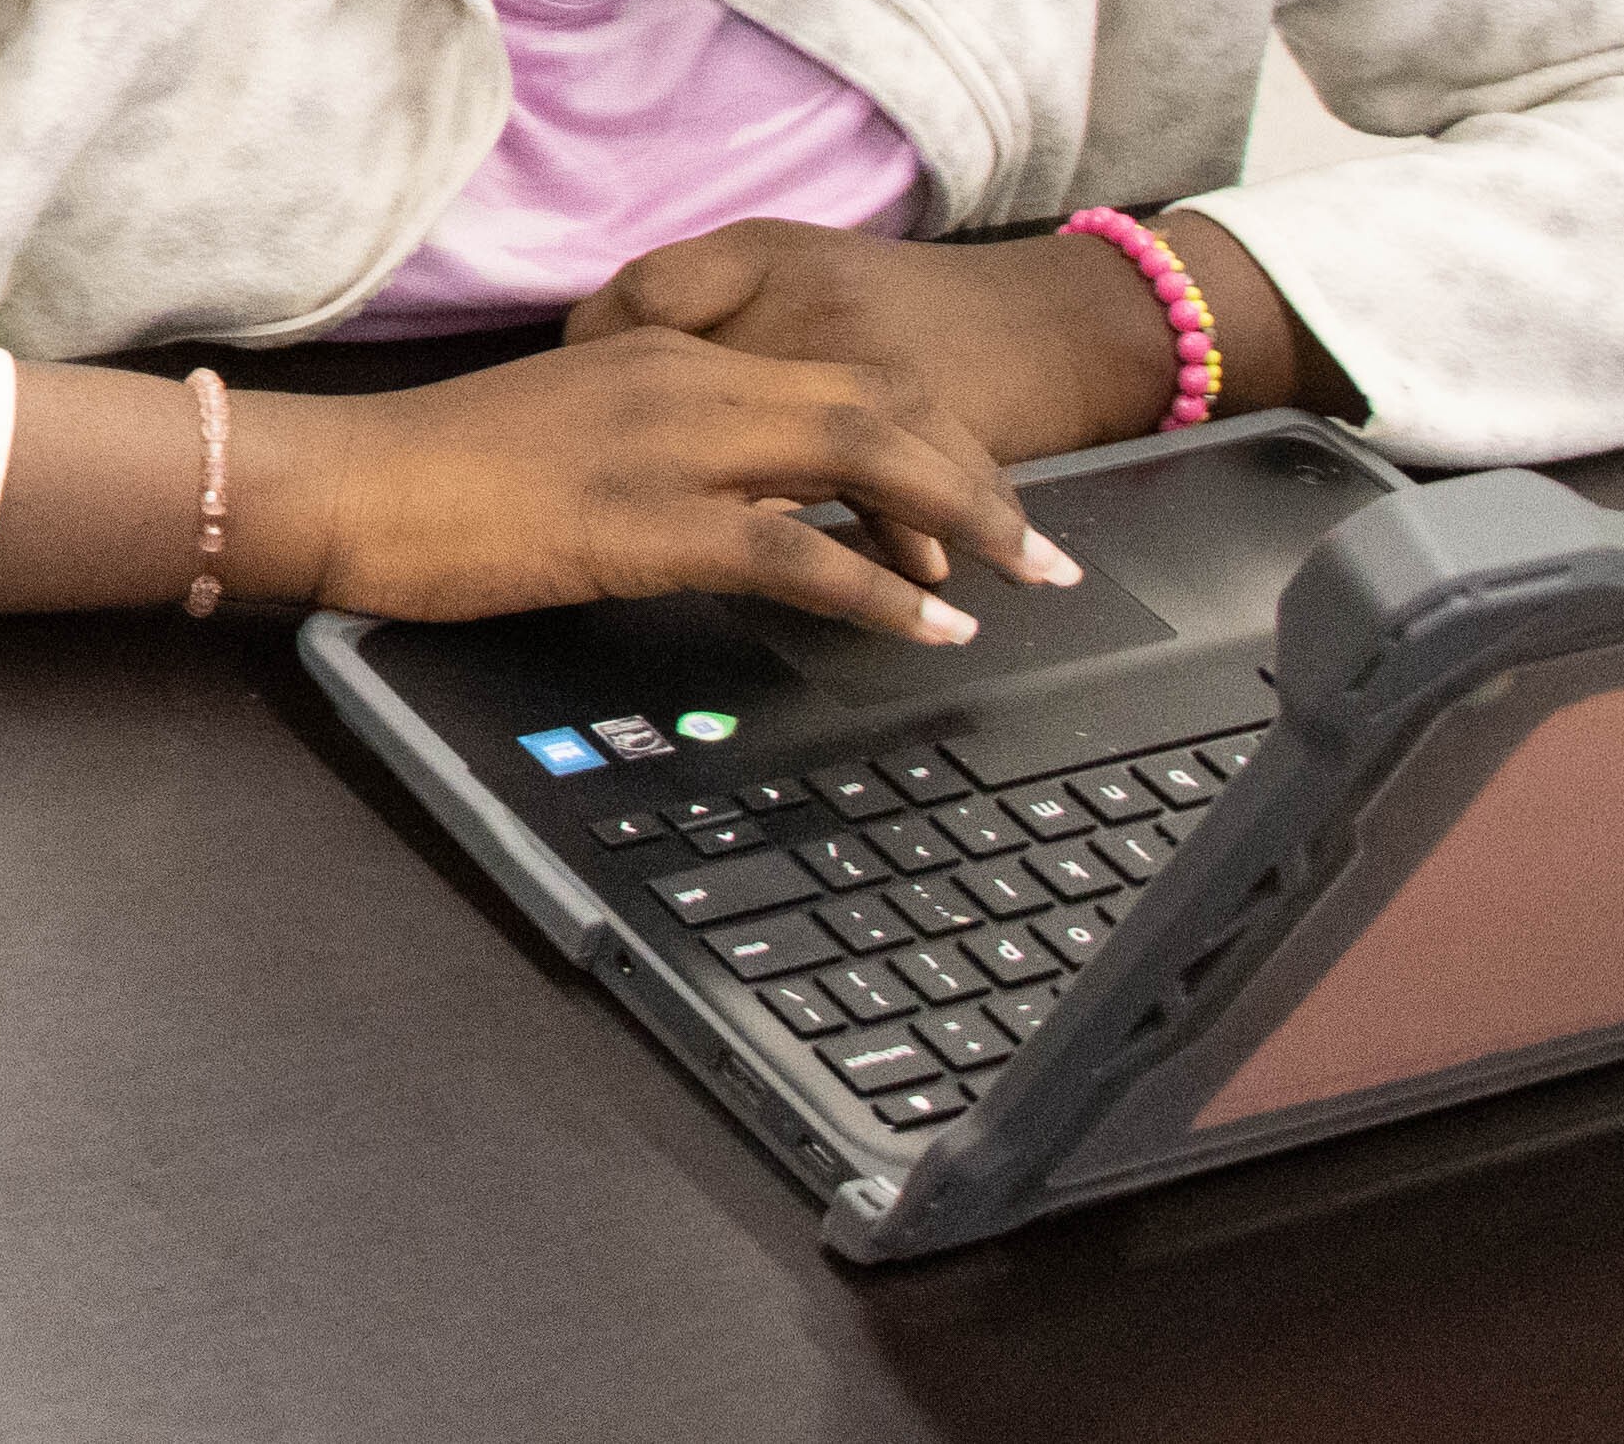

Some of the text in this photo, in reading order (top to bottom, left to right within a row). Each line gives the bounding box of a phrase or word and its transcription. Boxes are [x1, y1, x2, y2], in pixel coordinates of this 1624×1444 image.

[1166, 768, 1200, 788] b
[1099, 784, 1129, 802] n
[1029, 799, 1066, 819] m
[1058, 859, 1091, 880] k
[1066, 926, 1094, 944] o
[997, 938, 1025, 962] p
